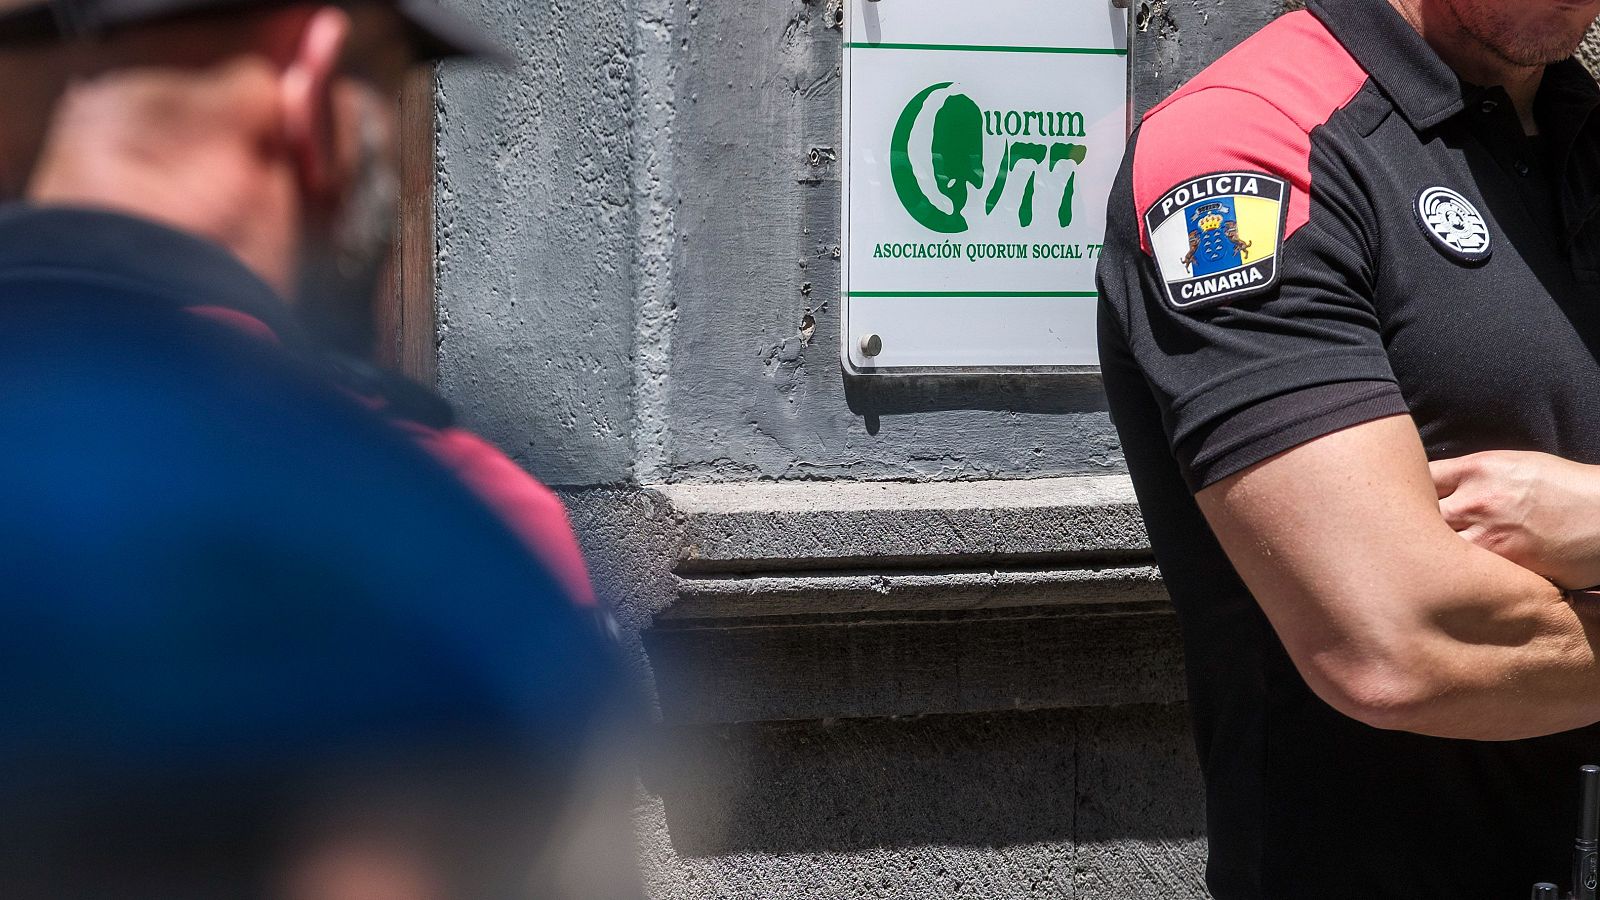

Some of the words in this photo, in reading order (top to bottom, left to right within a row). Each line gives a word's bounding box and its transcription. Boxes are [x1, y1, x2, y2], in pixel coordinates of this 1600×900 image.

[1008, 141, 1087, 228] 77
[1161, 176, 1259, 217] POLICIA
[873, 239, 962, 259] ASOCIACIÓN
[966, 243, 1028, 262] QUORUM
[1032, 243, 1083, 259] SOCIAL
[1086, 244, 1104, 259] 77
[1180, 266, 1263, 299] CANARIA
